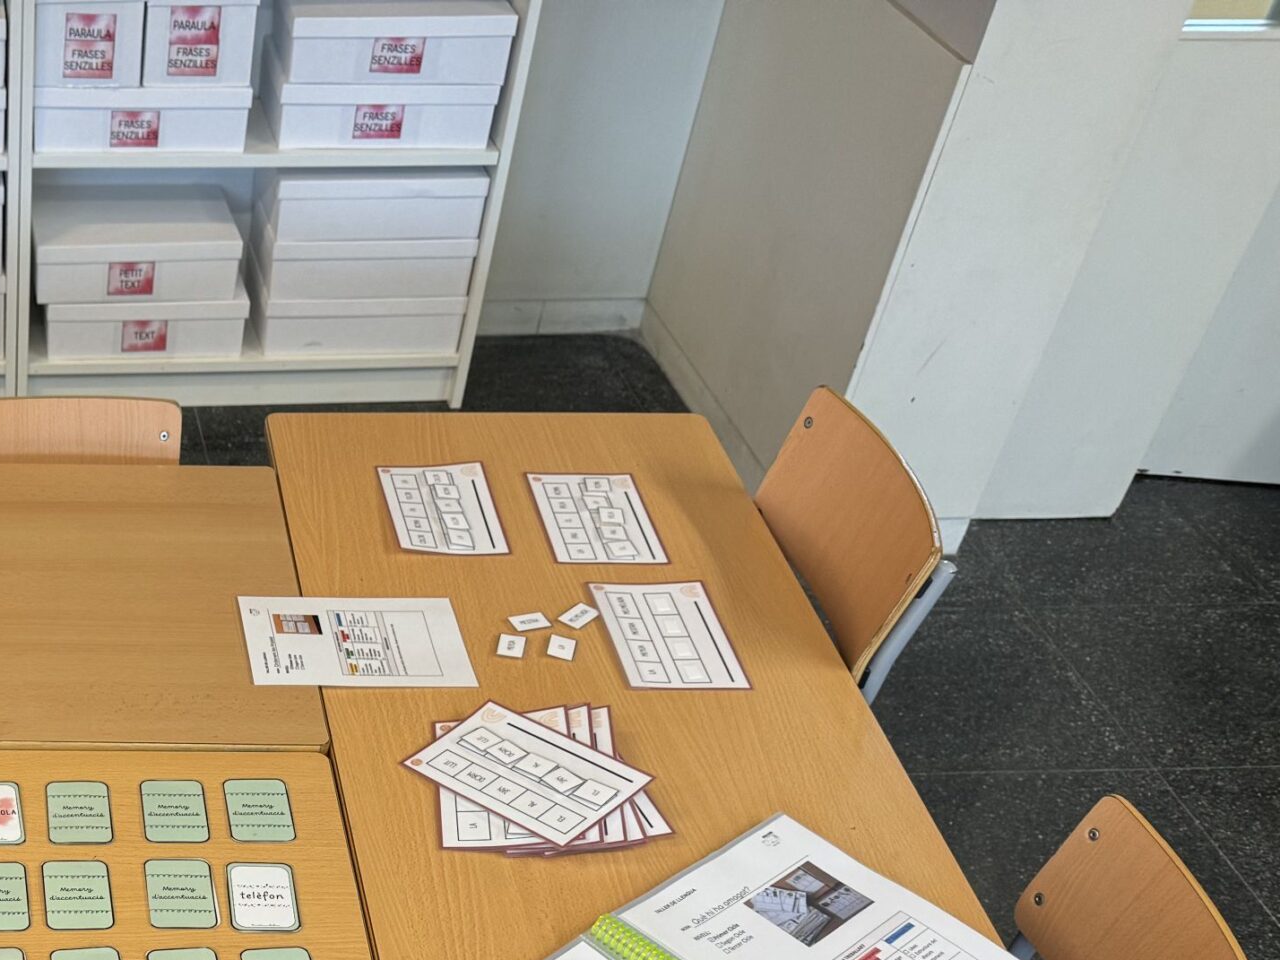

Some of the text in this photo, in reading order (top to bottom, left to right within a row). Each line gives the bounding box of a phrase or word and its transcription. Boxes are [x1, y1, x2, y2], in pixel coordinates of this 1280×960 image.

[173, 20, 216, 32] PARAULA
[68, 28, 112, 40] PARAULA
[176, 47, 210, 58] FRASES
[380, 43, 416, 54] FRASES
[72, 49, 106, 60] FRASES
[64, 60, 113, 72] SENZILLES
[168, 58, 217, 70] SENZILLES
[371, 55, 422, 67] SENZILLES
[362, 111, 396, 122] FRASES
[118, 120, 152, 130] FRASES
[354, 122, 402, 133] SENZILLES
[111, 129, 159, 141] SENZILLES
[120, 268, 142, 278] PETIT
[120, 280, 141, 289] TEXT
[134, 330, 155, 340] TEXT
[241, 802, 274, 810] Memory
[59, 886, 93, 894] Memory
[162, 885, 196, 894] Memory
[240, 890, 285, 902] telèfon
